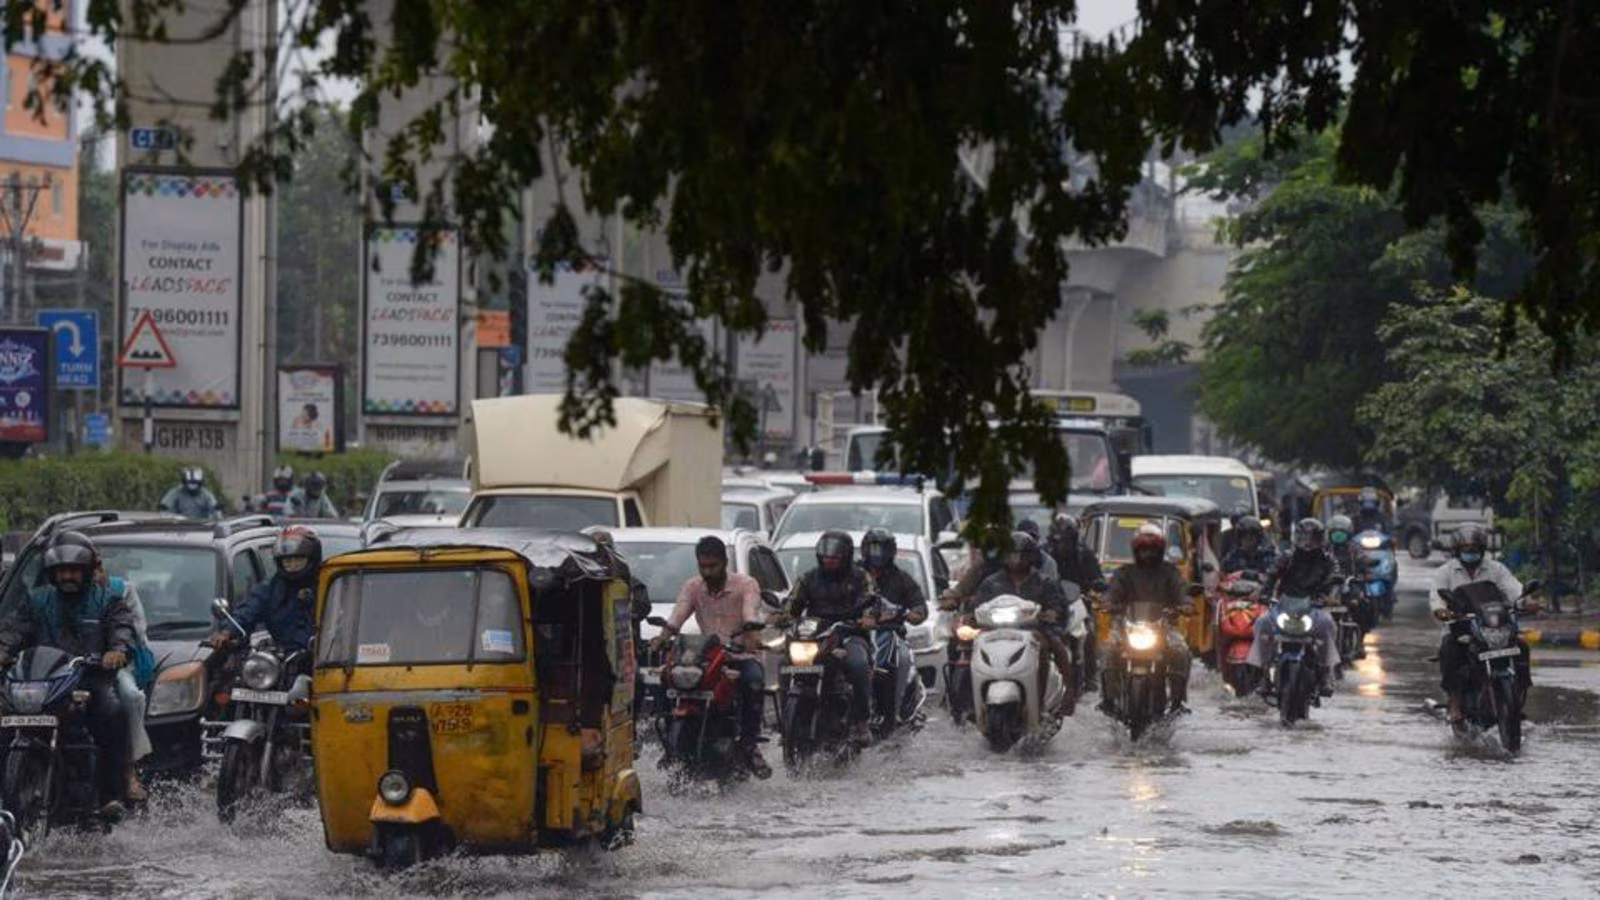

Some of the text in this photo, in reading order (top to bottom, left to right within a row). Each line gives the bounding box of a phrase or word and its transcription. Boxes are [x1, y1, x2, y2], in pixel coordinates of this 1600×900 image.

[148, 256, 213, 271] CONTACT
[130, 276, 232, 295] LEADSPACE
[386, 291, 438, 303] CONTACT
[130, 307, 229, 326] 796001111
[60, 362, 94, 374] TURN
